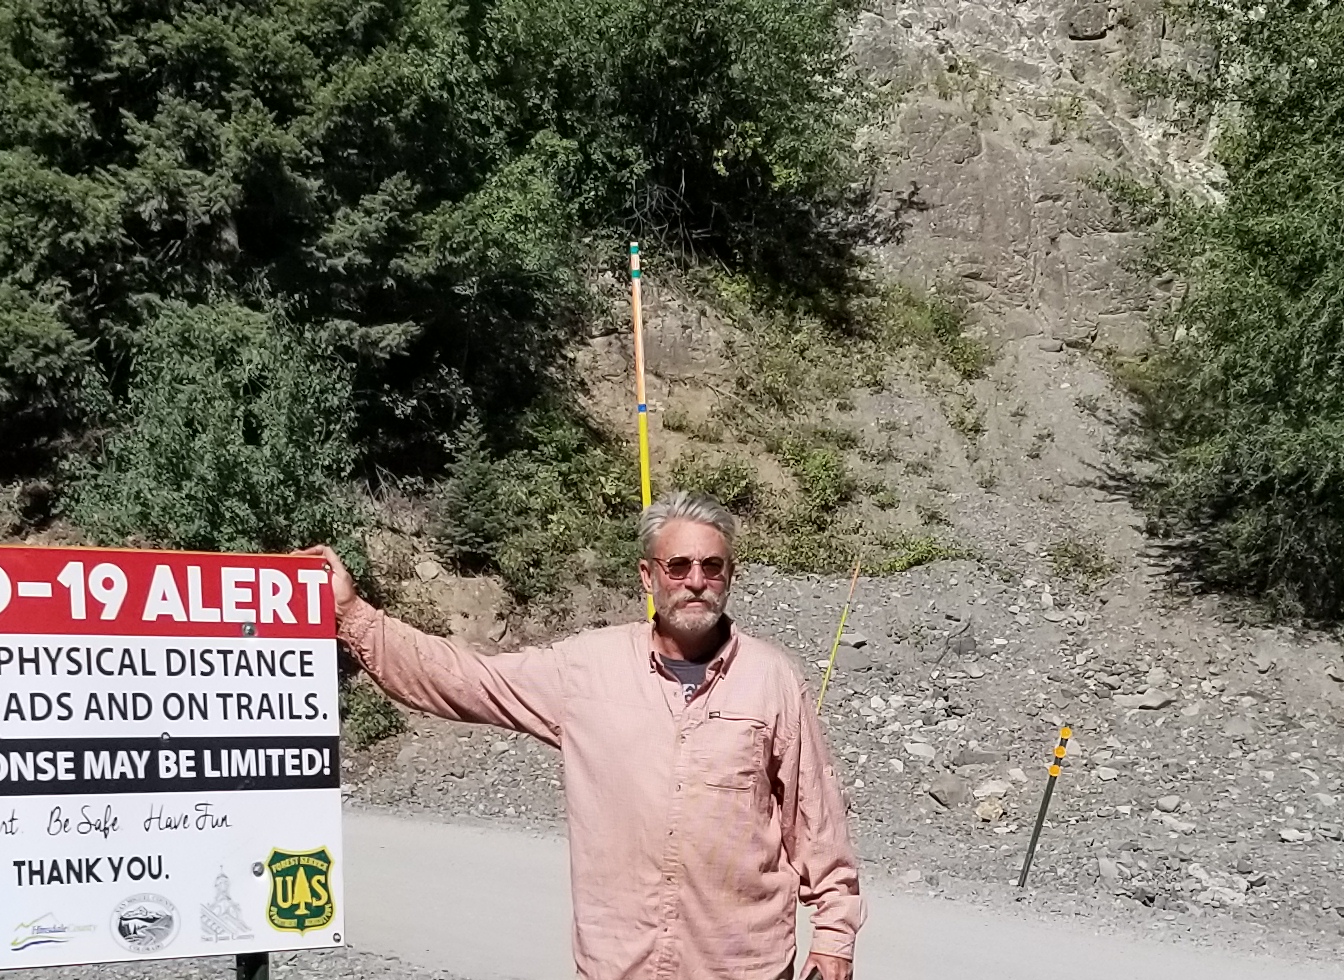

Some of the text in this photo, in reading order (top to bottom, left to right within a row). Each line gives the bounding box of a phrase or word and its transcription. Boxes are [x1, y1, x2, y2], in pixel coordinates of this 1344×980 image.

[142, 562, 329, 625] ALERT
[166, 649, 315, 678] DISTANCE
[83, 692, 153, 721] AND
[162, 692, 209, 721] ON
[219, 692, 328, 721] TRAILS.
[84, 751, 151, 780] MAY
[158, 750, 197, 779] BE
[204, 749, 331, 778] LIMITED!
[46, 805, 72, 836] Be
[143, 803, 190, 833] Have
[194, 802, 233, 831] Fun
[12, 854, 170, 887] THANK YOU.
